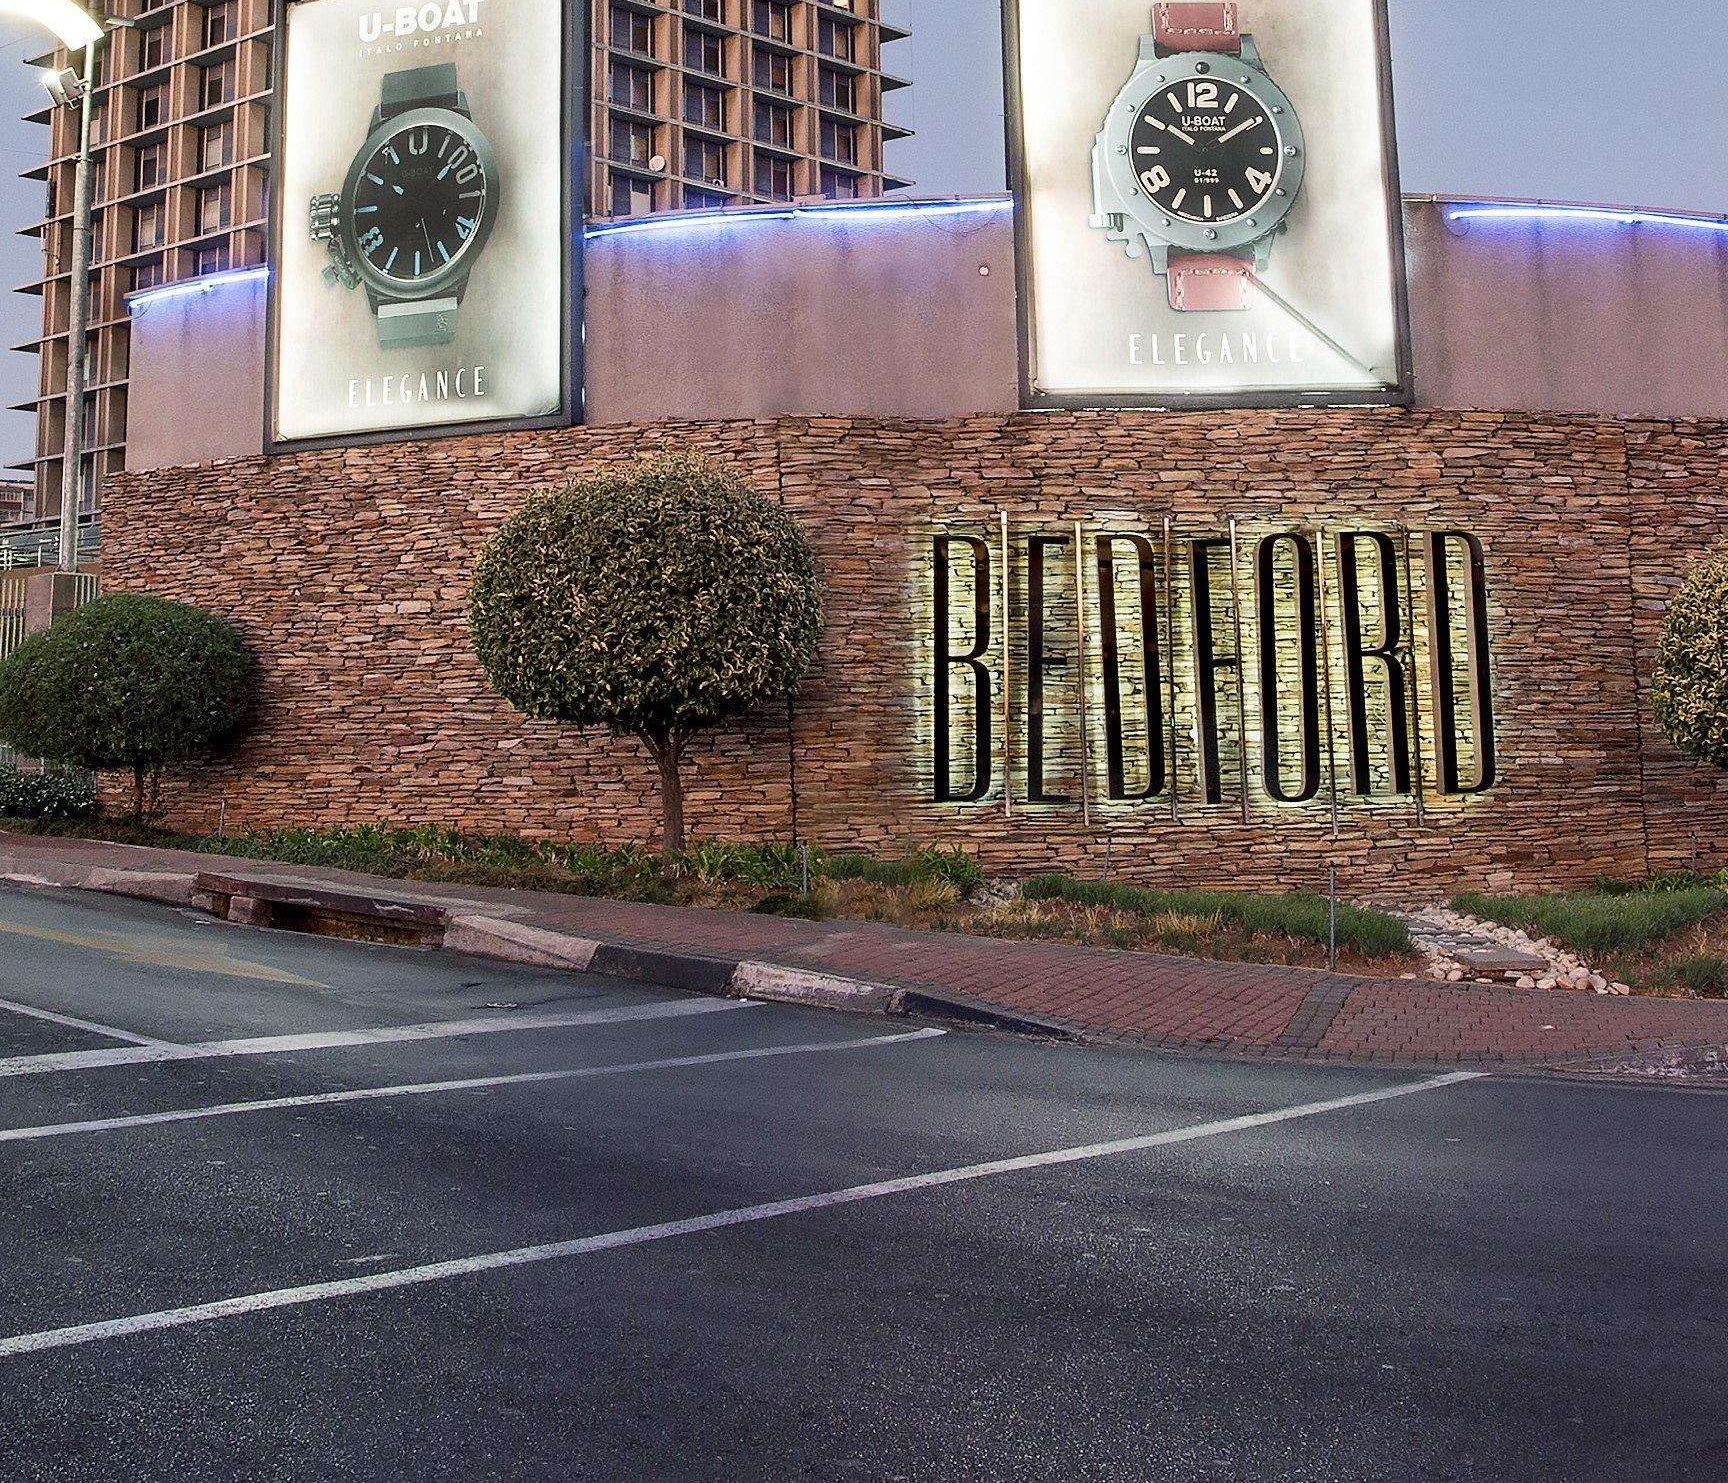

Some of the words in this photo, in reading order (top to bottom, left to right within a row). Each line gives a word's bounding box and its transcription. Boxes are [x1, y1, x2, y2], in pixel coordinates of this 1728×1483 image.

[358, 42, 403, 57] ITALO
[413, 28, 484, 48] FONTANA
[1186, 81, 1219, 108] 12
[1181, 116, 1226, 126] U-BOAT
[1193, 169, 1218, 177] U-42
[1244, 166, 1273, 195] 4
[1127, 331, 1304, 366] ELEGANCE
[347, 365, 486, 409] ELEGANCE
[933, 531, 1496, 805] BEDFORD
